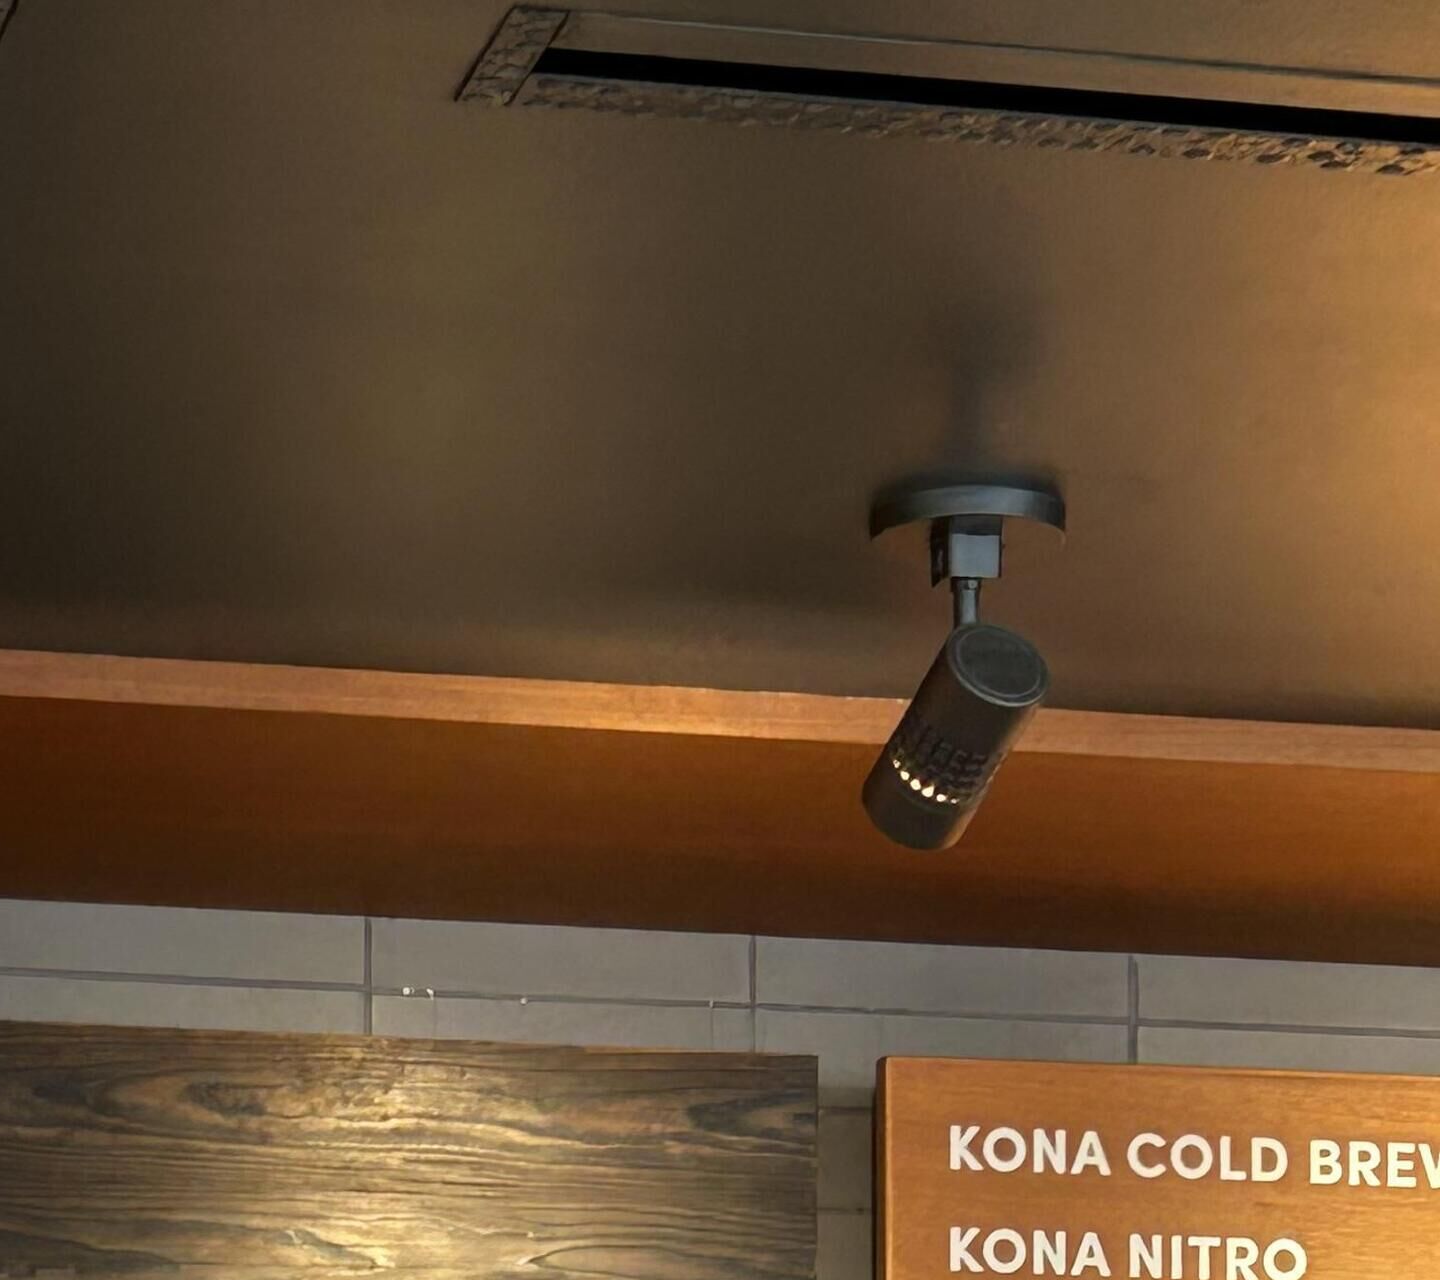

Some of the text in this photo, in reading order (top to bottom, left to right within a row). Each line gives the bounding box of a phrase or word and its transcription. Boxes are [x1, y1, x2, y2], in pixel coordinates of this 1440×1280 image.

[949, 1124, 1111, 1176] KONA
[1126, 1132, 1288, 1182] COLD
[949, 1226, 1111, 1277] KONA
